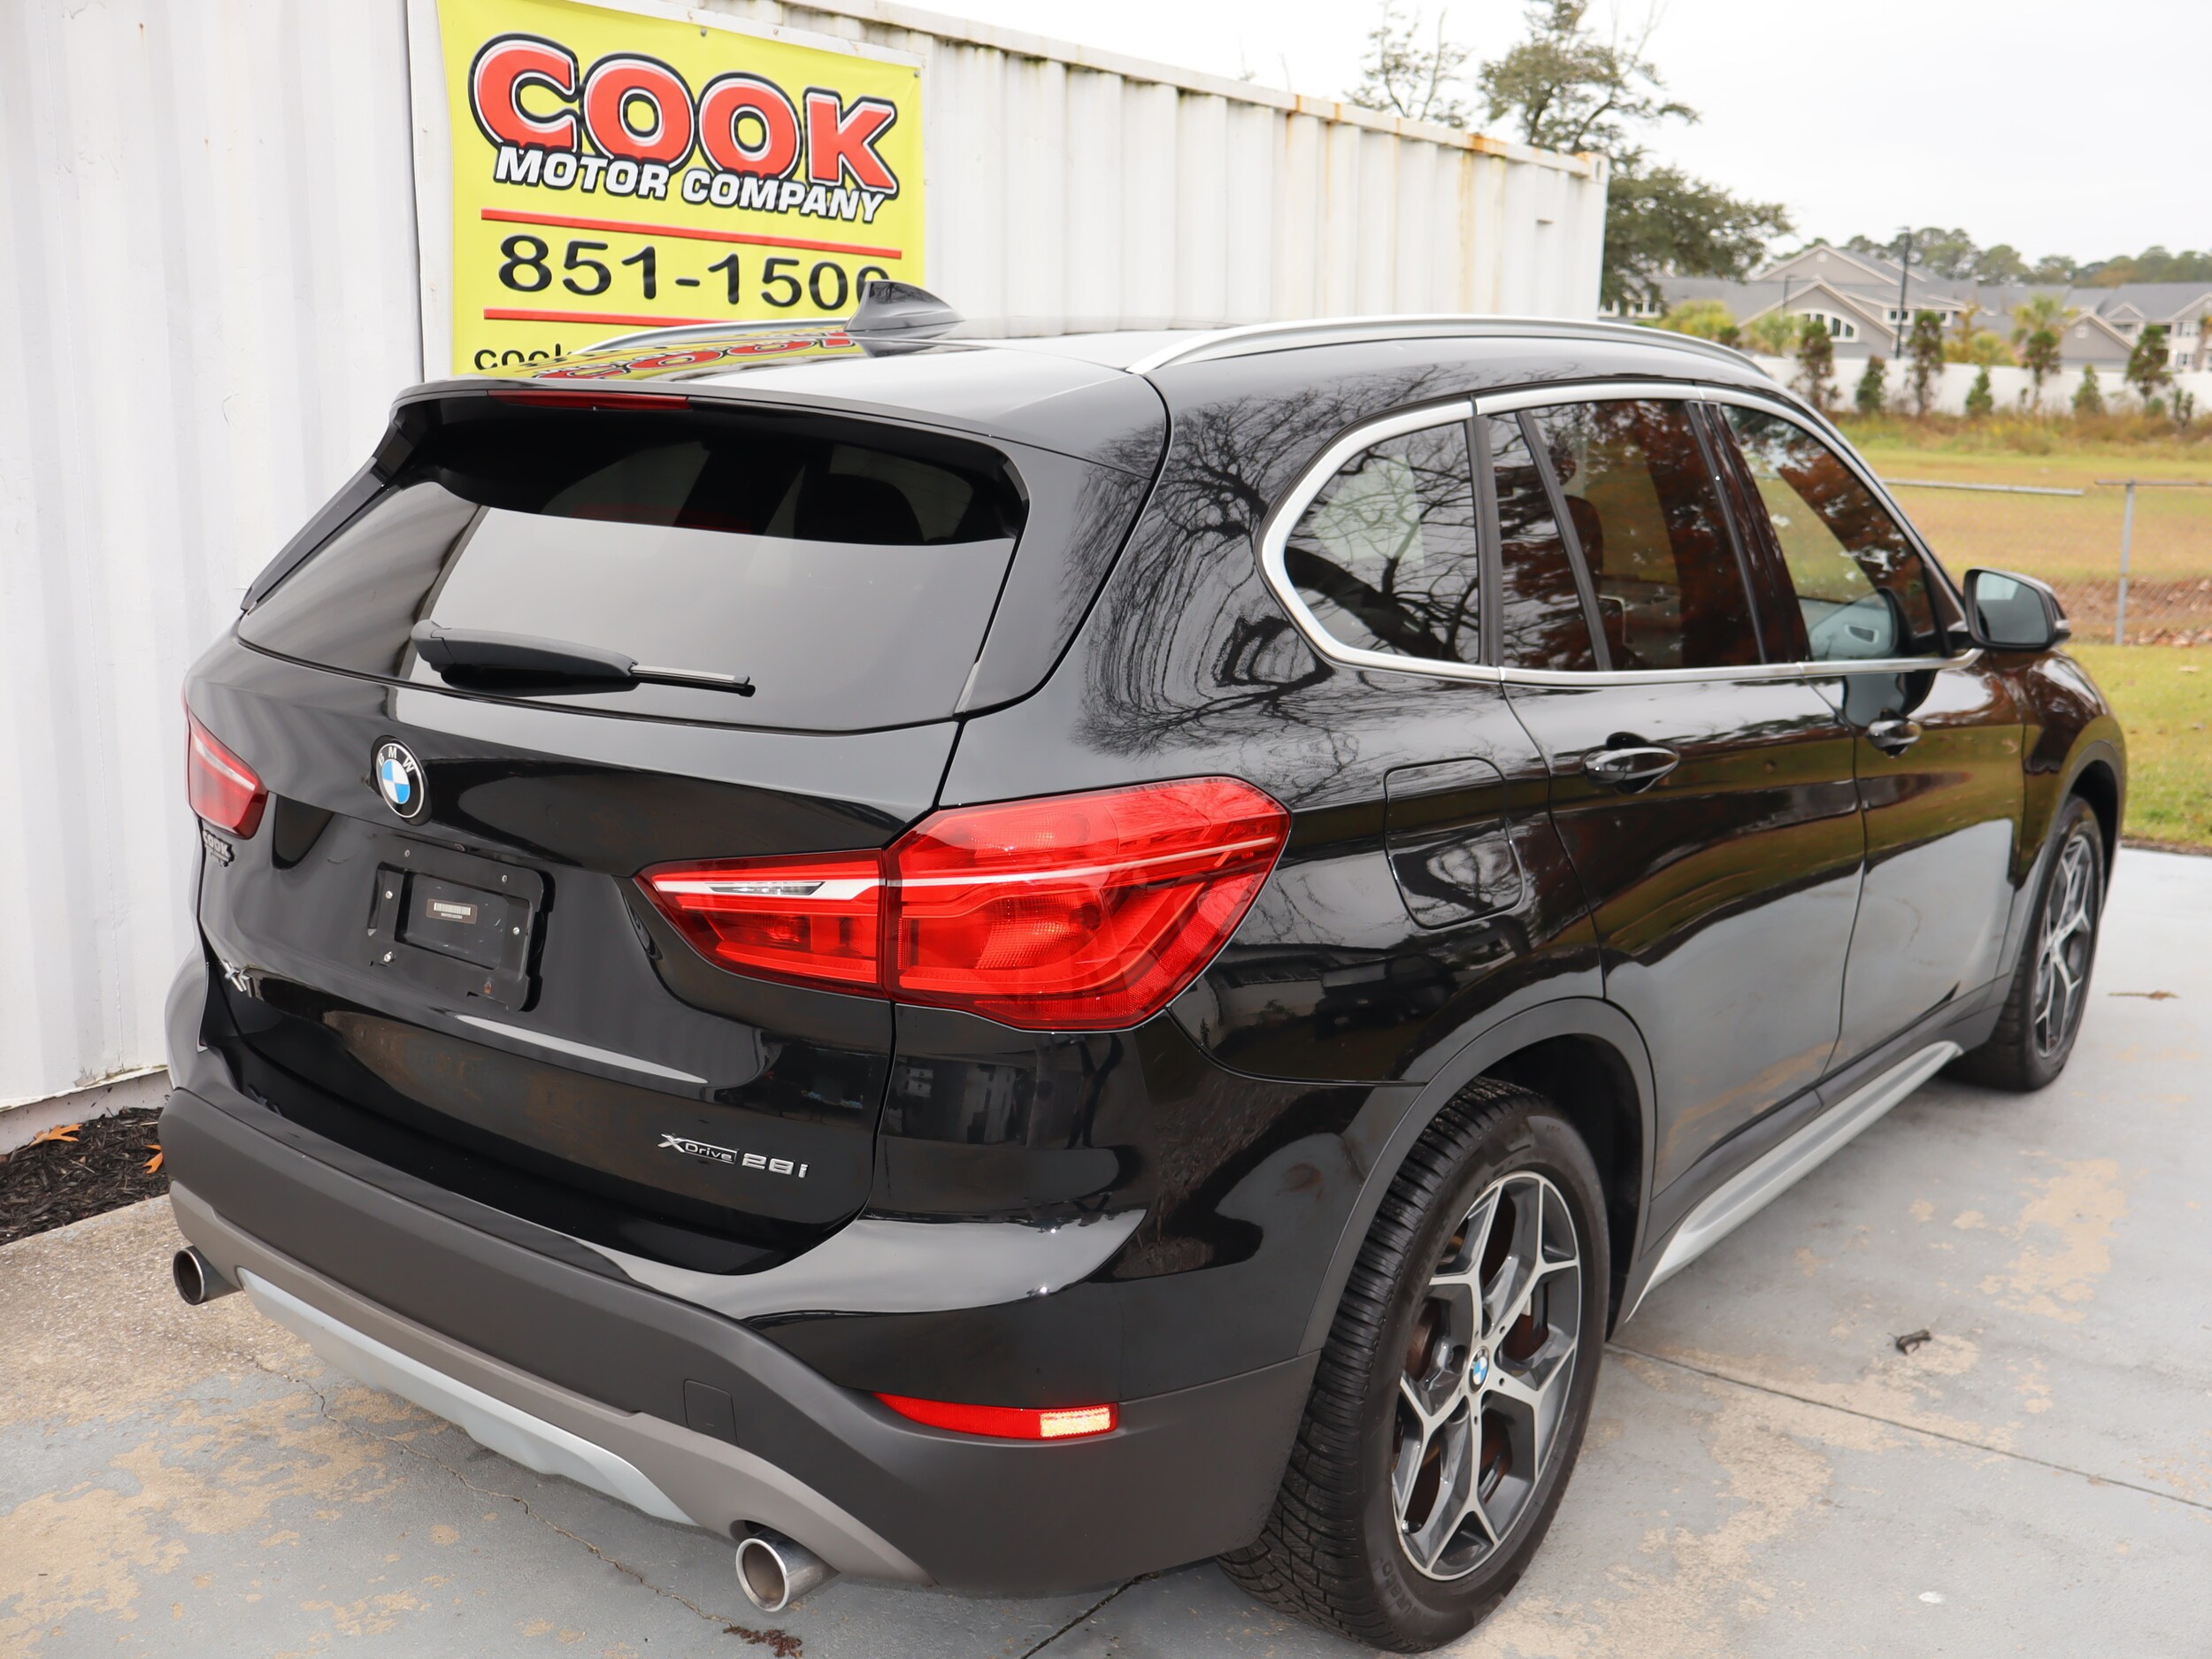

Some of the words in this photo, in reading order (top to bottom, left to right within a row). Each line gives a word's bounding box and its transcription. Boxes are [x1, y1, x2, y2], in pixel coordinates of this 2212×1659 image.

[469, 33, 897, 196] COOK
[495, 145, 672, 200] MOTOR
[681, 168, 886, 224] COMPANY
[377, 746, 416, 774] BMW
[741, 1152, 809, 1179] 28i
